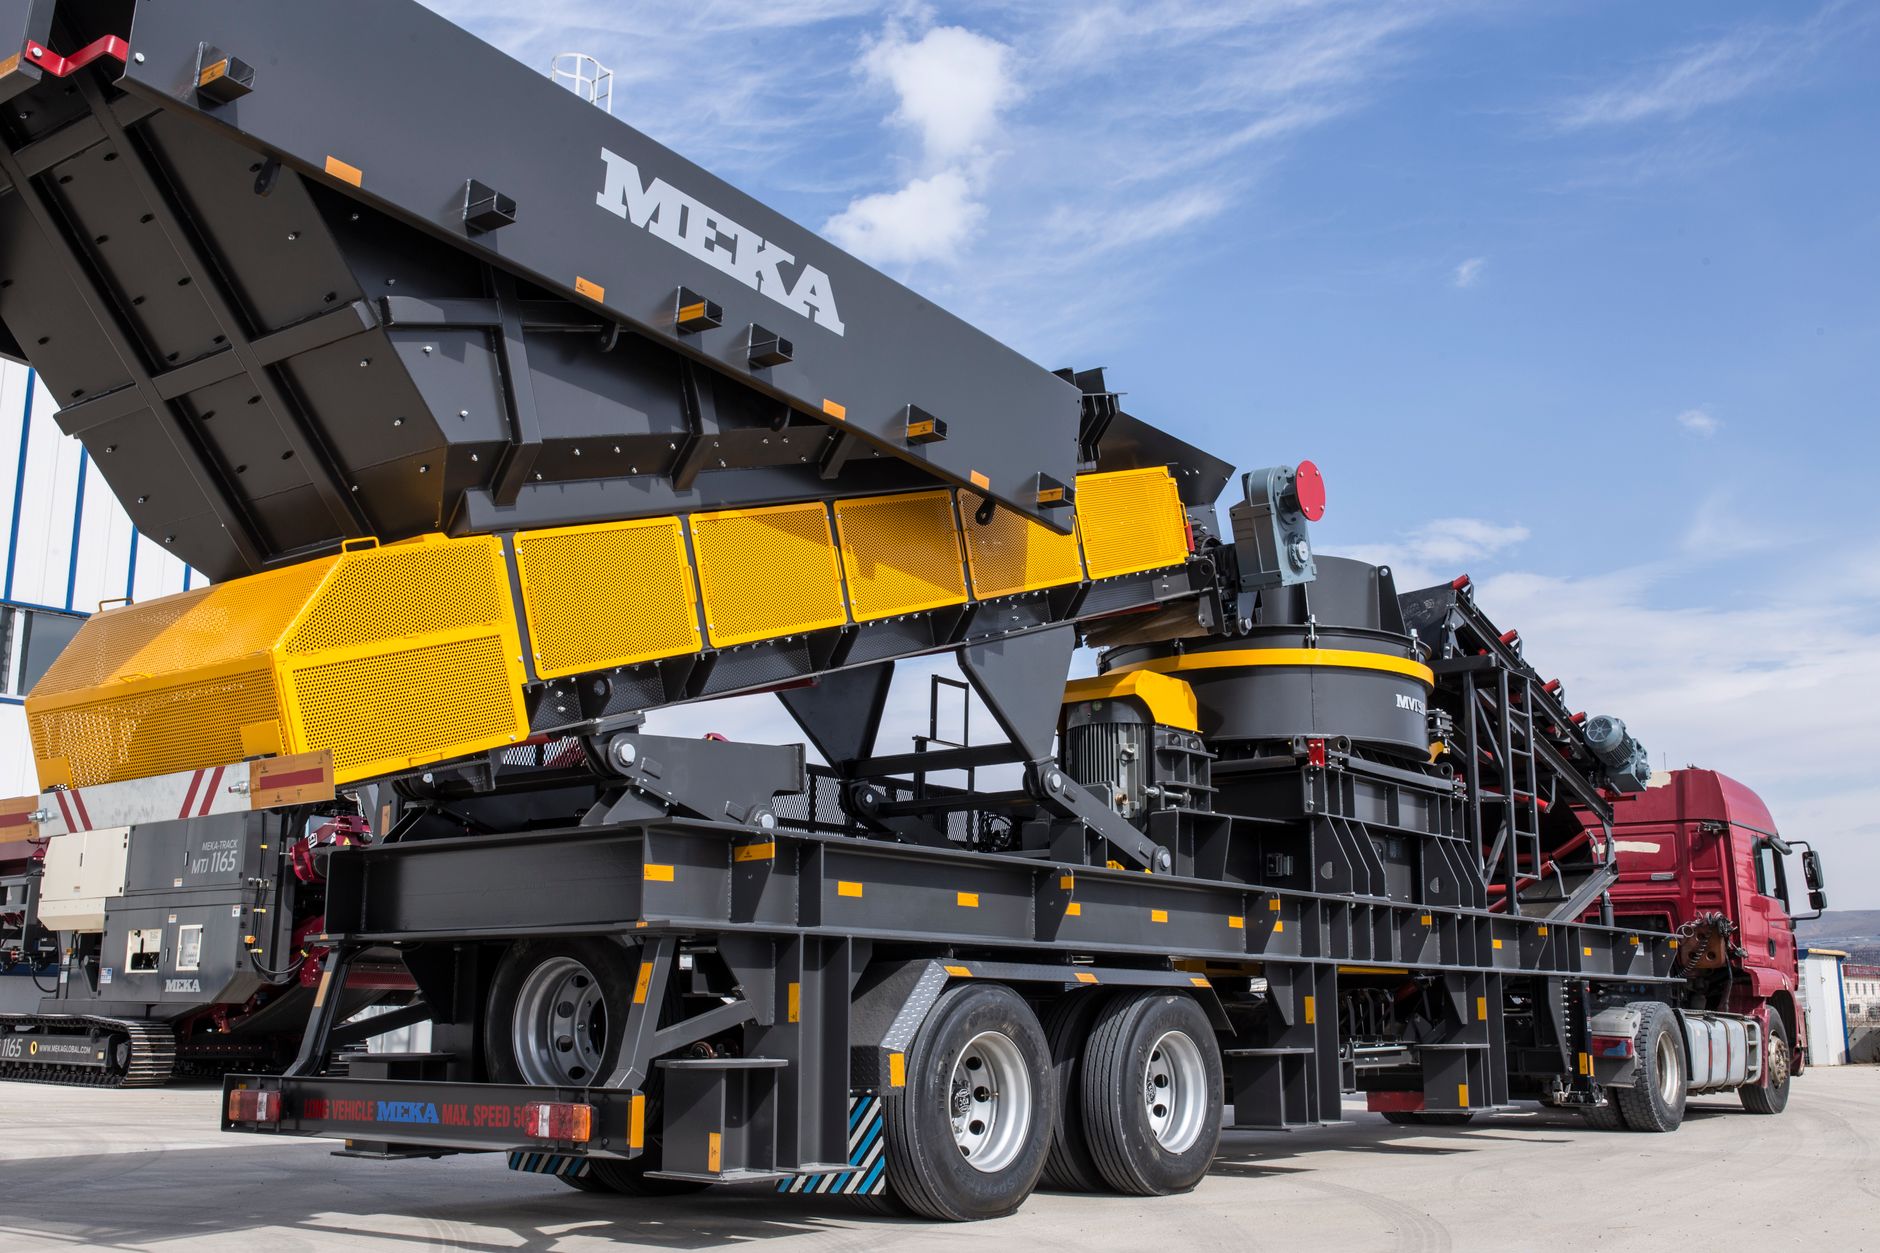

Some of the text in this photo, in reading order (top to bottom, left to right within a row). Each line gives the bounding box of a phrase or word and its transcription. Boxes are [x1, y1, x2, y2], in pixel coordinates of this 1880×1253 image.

[596, 146, 845, 337] MEKA
[202, 839, 239, 851] MEKA-TRACK
[210, 850, 238, 872] 1165
[165, 979, 200, 992] MEKA
[2, 1039, 23, 1057] 1165
[39, 1044, 91, 1054] WWW.MEKAGLOBAL.COM
[332, 1100, 374, 1120] VEHICLE
[376, 1101, 439, 1123] MEKA
[442, 1104, 471, 1126] MAX.
[473, 1105, 511, 1128] SPEED
